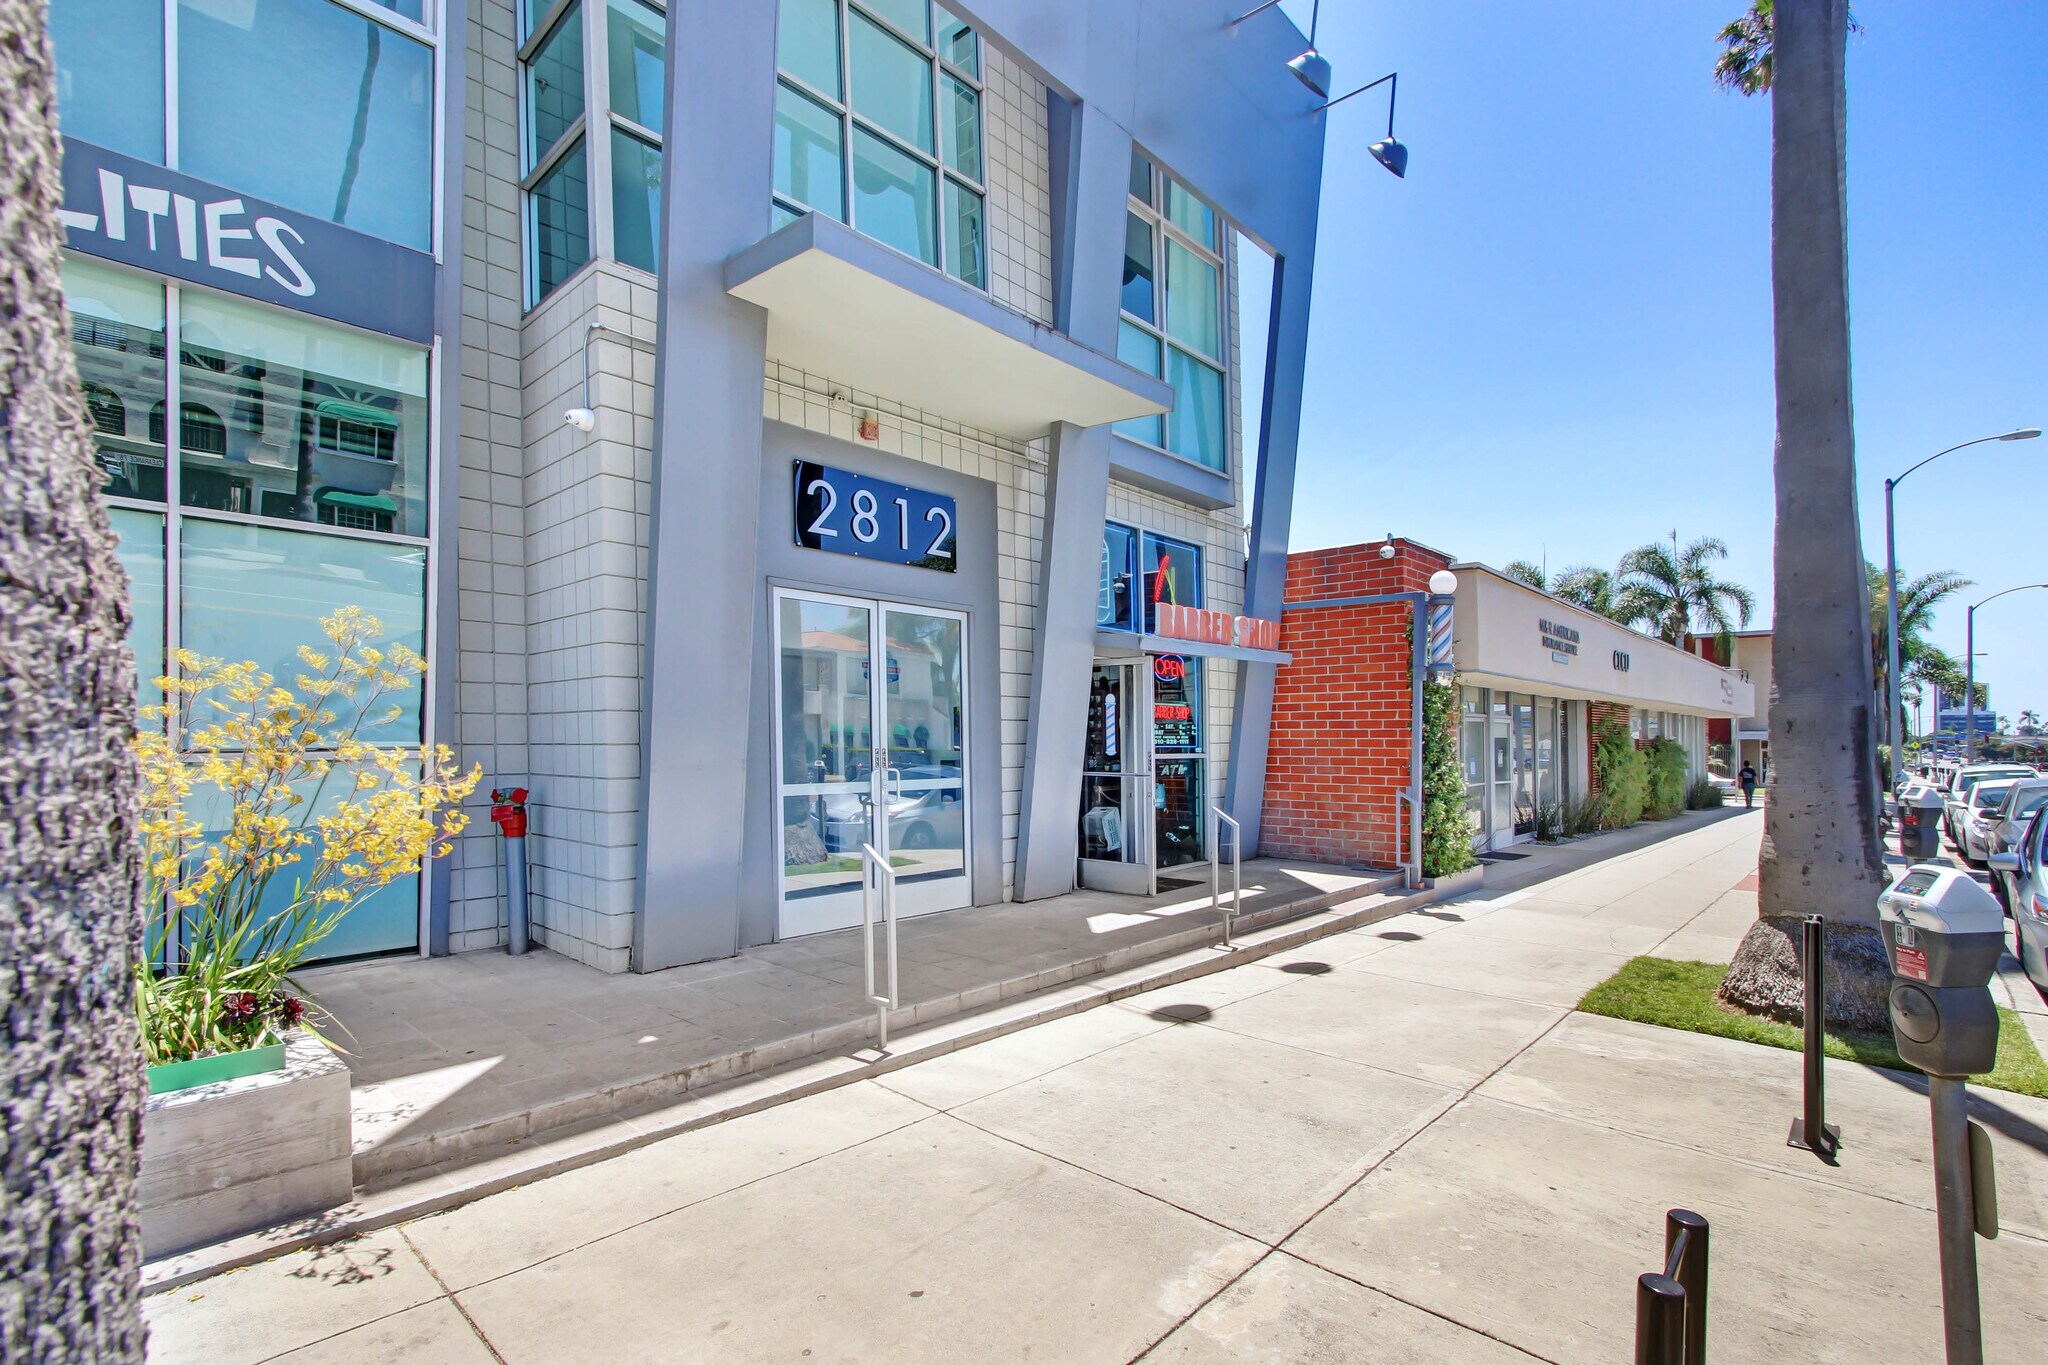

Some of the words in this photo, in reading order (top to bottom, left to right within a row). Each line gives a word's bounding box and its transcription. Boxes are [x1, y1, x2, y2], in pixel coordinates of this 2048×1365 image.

[806, 479, 952, 559] 2812
[1155, 602, 1233, 646] BARBER
[1234, 615, 1281, 652] SHOP
[1155, 658, 1185, 679] OPEN
[1176, 706, 1190, 720] SHOP
